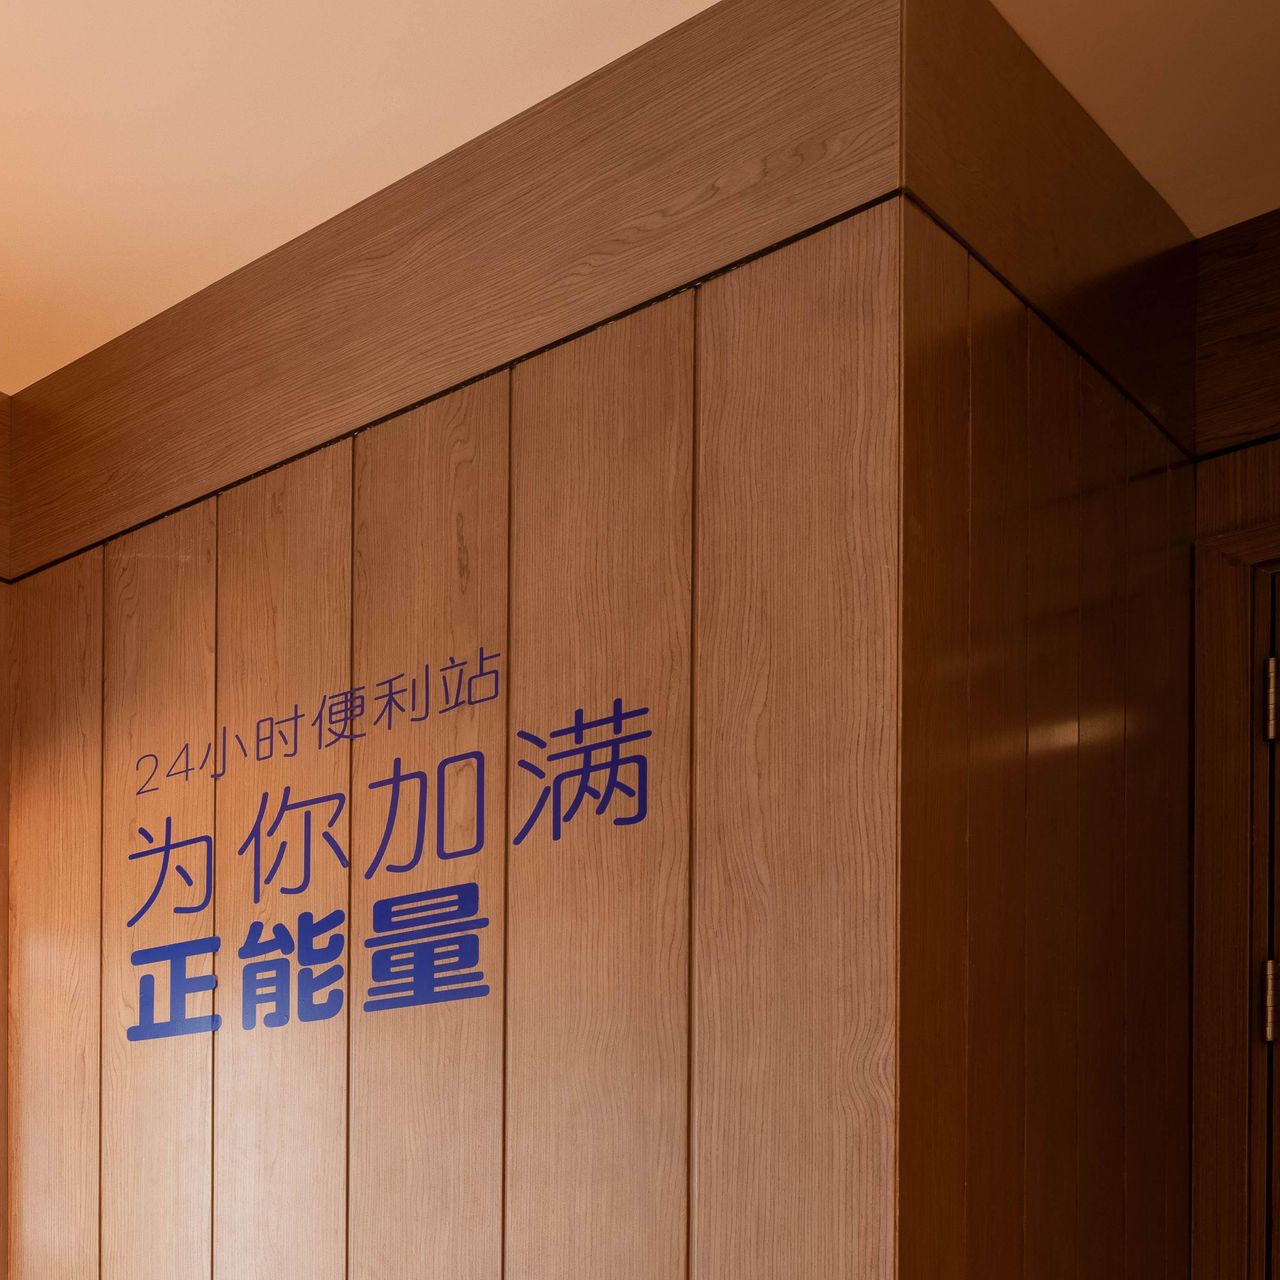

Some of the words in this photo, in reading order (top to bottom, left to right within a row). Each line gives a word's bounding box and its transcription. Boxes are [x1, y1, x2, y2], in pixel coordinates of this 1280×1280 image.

[135, 647, 501, 796] 24小时便利站
[127, 698, 652, 928] 为你加满
[127, 882, 490, 1042] 正能量
